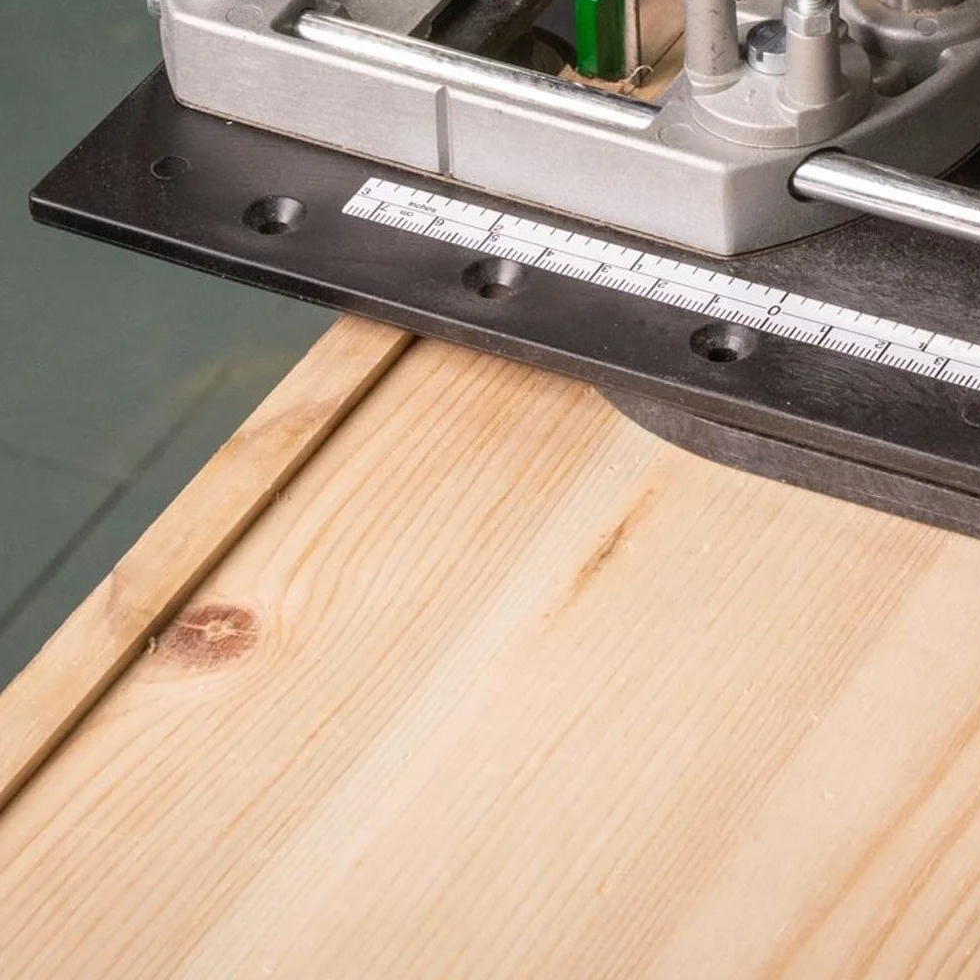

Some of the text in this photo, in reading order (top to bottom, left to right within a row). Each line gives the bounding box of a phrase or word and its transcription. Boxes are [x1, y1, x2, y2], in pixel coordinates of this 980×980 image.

[361, 187, 372, 196] 3
[408, 201, 437, 213] inches
[493, 223, 504, 232] 2
[767, 305, 782, 316] 0
